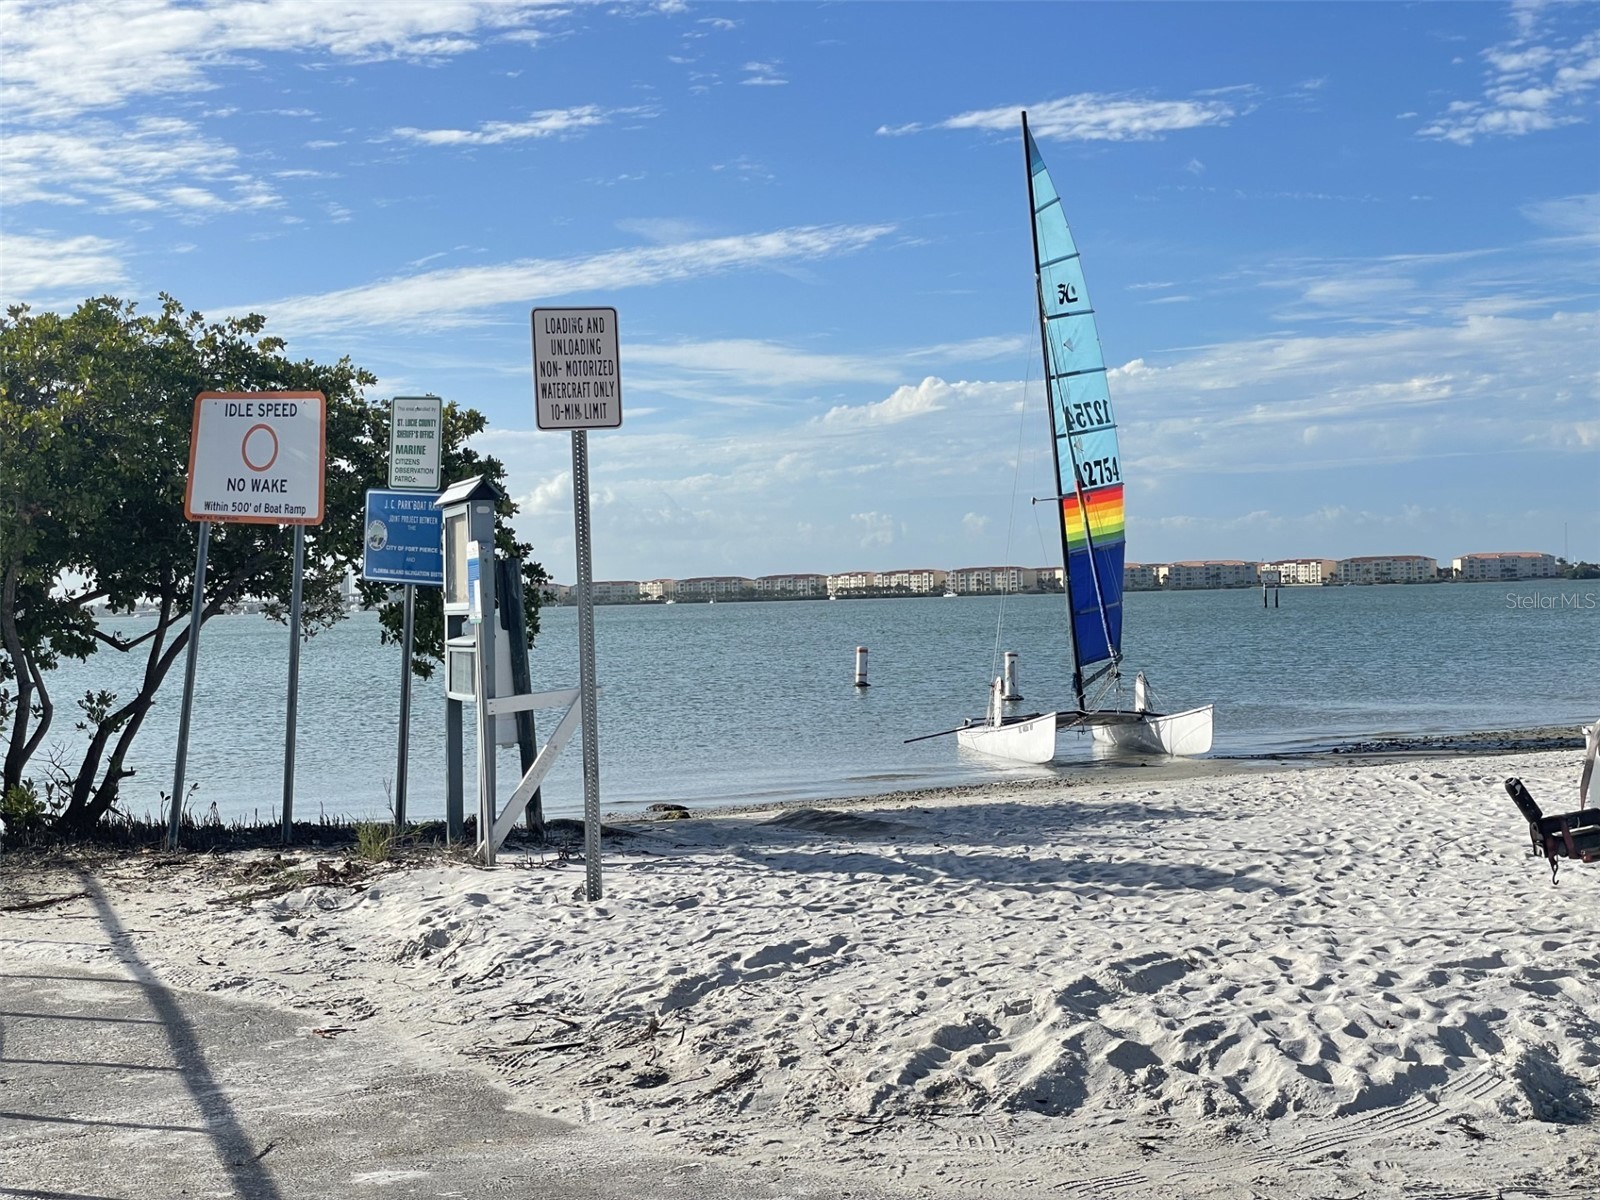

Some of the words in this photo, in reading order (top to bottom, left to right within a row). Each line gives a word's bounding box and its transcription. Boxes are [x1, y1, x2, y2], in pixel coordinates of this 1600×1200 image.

[545, 317, 584, 334] LOADING
[587, 317, 605, 334] AND
[551, 338, 602, 356] UNLOADING
[540, 361, 562, 377] NON-
[565, 360, 614, 377] MOTORIZED
[540, 382, 590, 399] WATERCRAFT
[593, 381, 615, 398] ONLY
[225, 403, 253, 417] IDLE
[258, 403, 297, 417] SPEED
[551, 404, 581, 420] 10-MIN
[584, 403, 607, 420] LIMIT
[418, 418, 436, 428] COUNTY
[396, 430, 419, 439] SHERIFF'S
[419, 430, 435, 439] OFFICE
[395, 444, 427, 456] MARINE
[395, 458, 421, 466] CITIZENS
[394, 467, 435, 475] OBSERVATION
[226, 478, 246, 492] NO
[251, 478, 288, 493] WAKE
[204, 501, 229, 512] Within
[231, 502, 252, 513] 500'
[253, 502, 262, 513] of
[264, 503, 282, 514] Boat
[284, 503, 307, 517] Ramp
[397, 499, 411, 510] PARK
[412, 500, 427, 511] BOAT
[419, 516, 438, 525] BETWEEN
